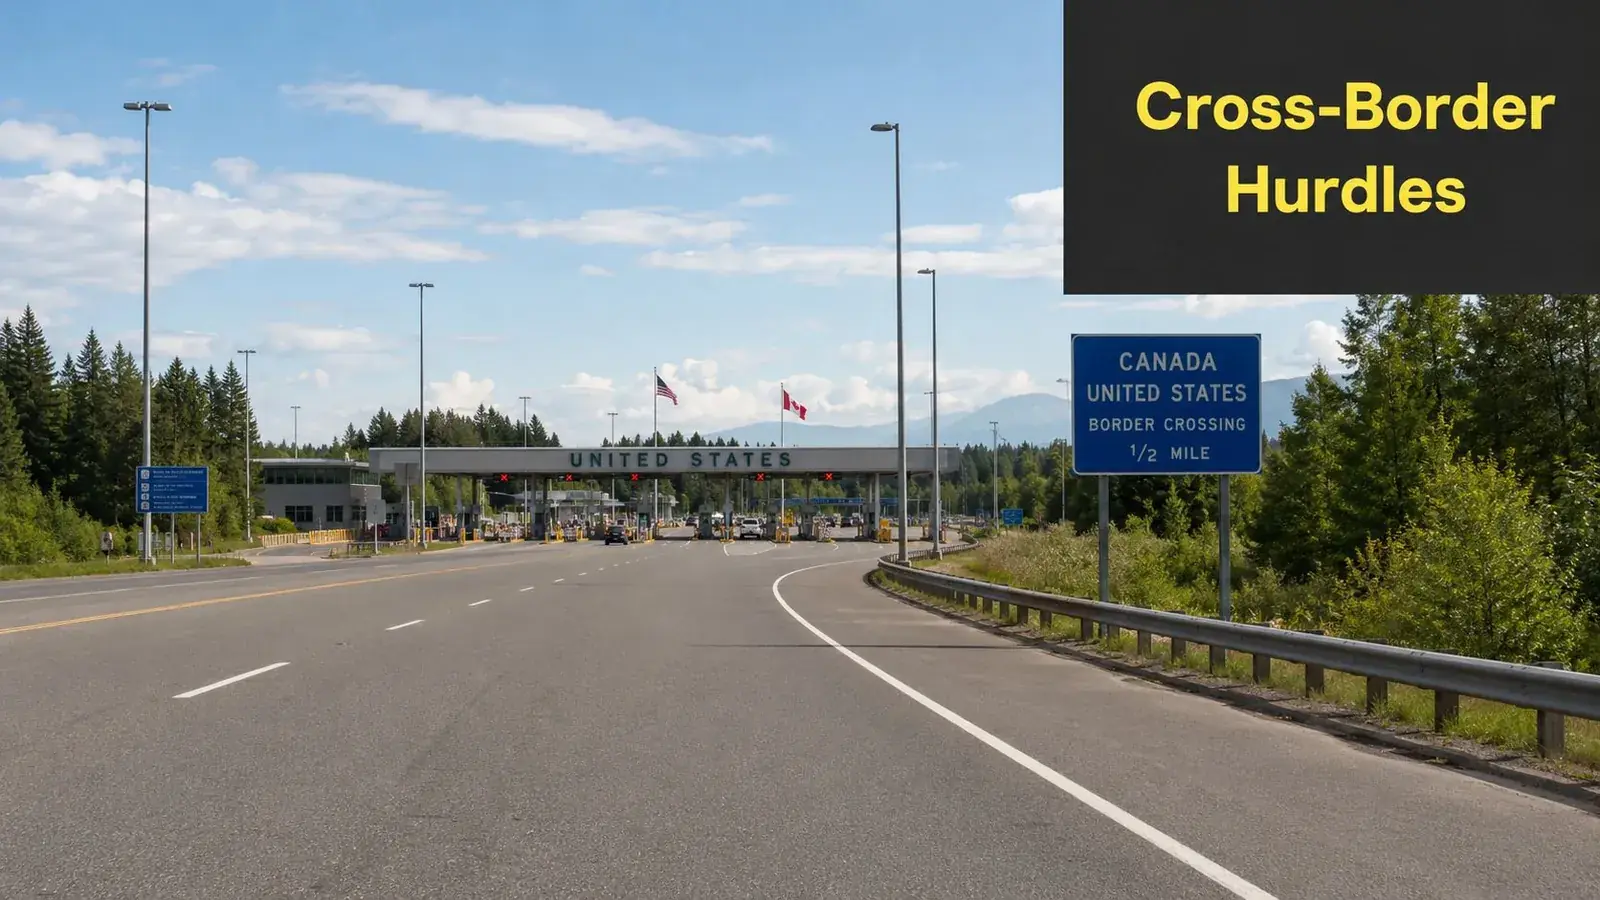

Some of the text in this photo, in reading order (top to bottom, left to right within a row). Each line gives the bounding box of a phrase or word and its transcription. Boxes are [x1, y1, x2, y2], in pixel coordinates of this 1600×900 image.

[1119, 352, 1217, 371] CANADA
[1087, 384, 1247, 402] UNITED STATES
[1089, 418, 1246, 431] BORDER CROSSING
[570, 452, 791, 467] UNITED STATES
[1130, 444, 1210, 462] 1/2 MILE
